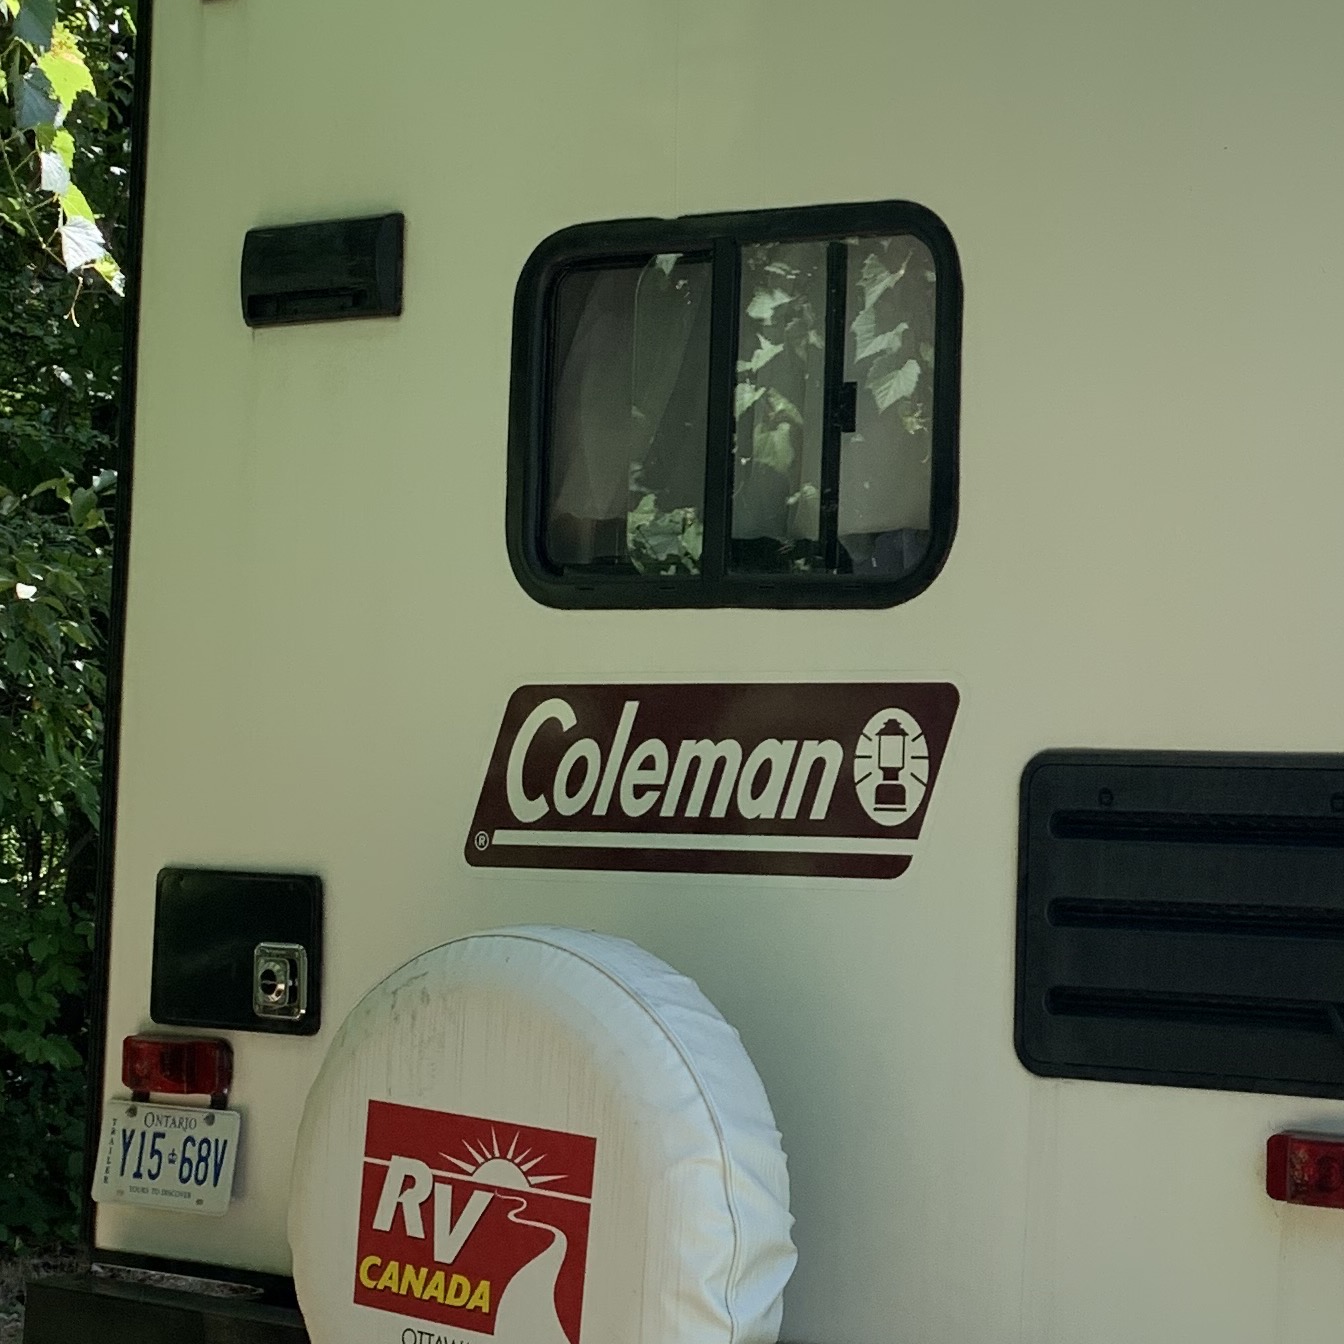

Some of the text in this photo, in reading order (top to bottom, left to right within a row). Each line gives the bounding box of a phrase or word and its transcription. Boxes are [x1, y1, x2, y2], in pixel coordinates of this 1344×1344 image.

[506, 697, 844, 823] Coleman
[103, 1118, 118, 1185] TRAILER
[144, 1112, 197, 1132] ONTARIO
[372, 1154, 496, 1265] RV
[359, 1255, 491, 1313] CANADA
